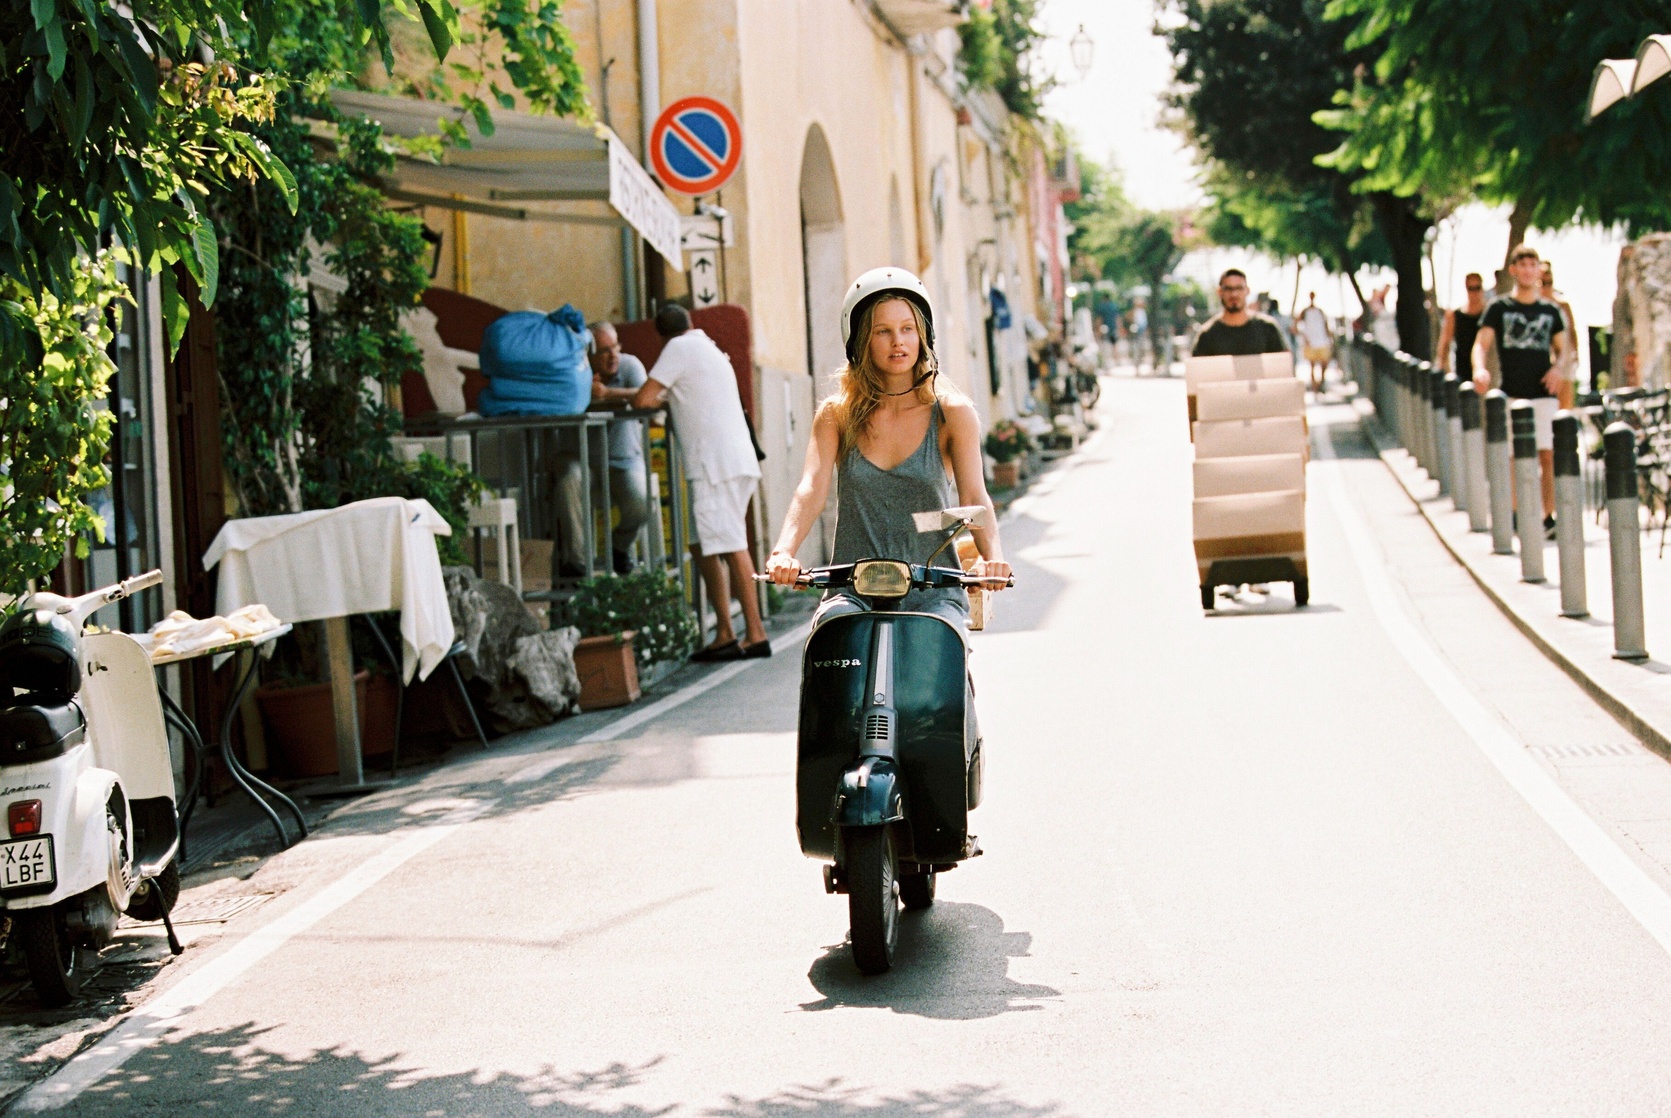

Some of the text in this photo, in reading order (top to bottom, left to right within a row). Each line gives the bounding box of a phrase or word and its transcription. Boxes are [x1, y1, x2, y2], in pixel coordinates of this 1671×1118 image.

[813, 658, 862, 669] vespa
[5, 841, 43, 864] X44
[6, 862, 44, 885] LBF
